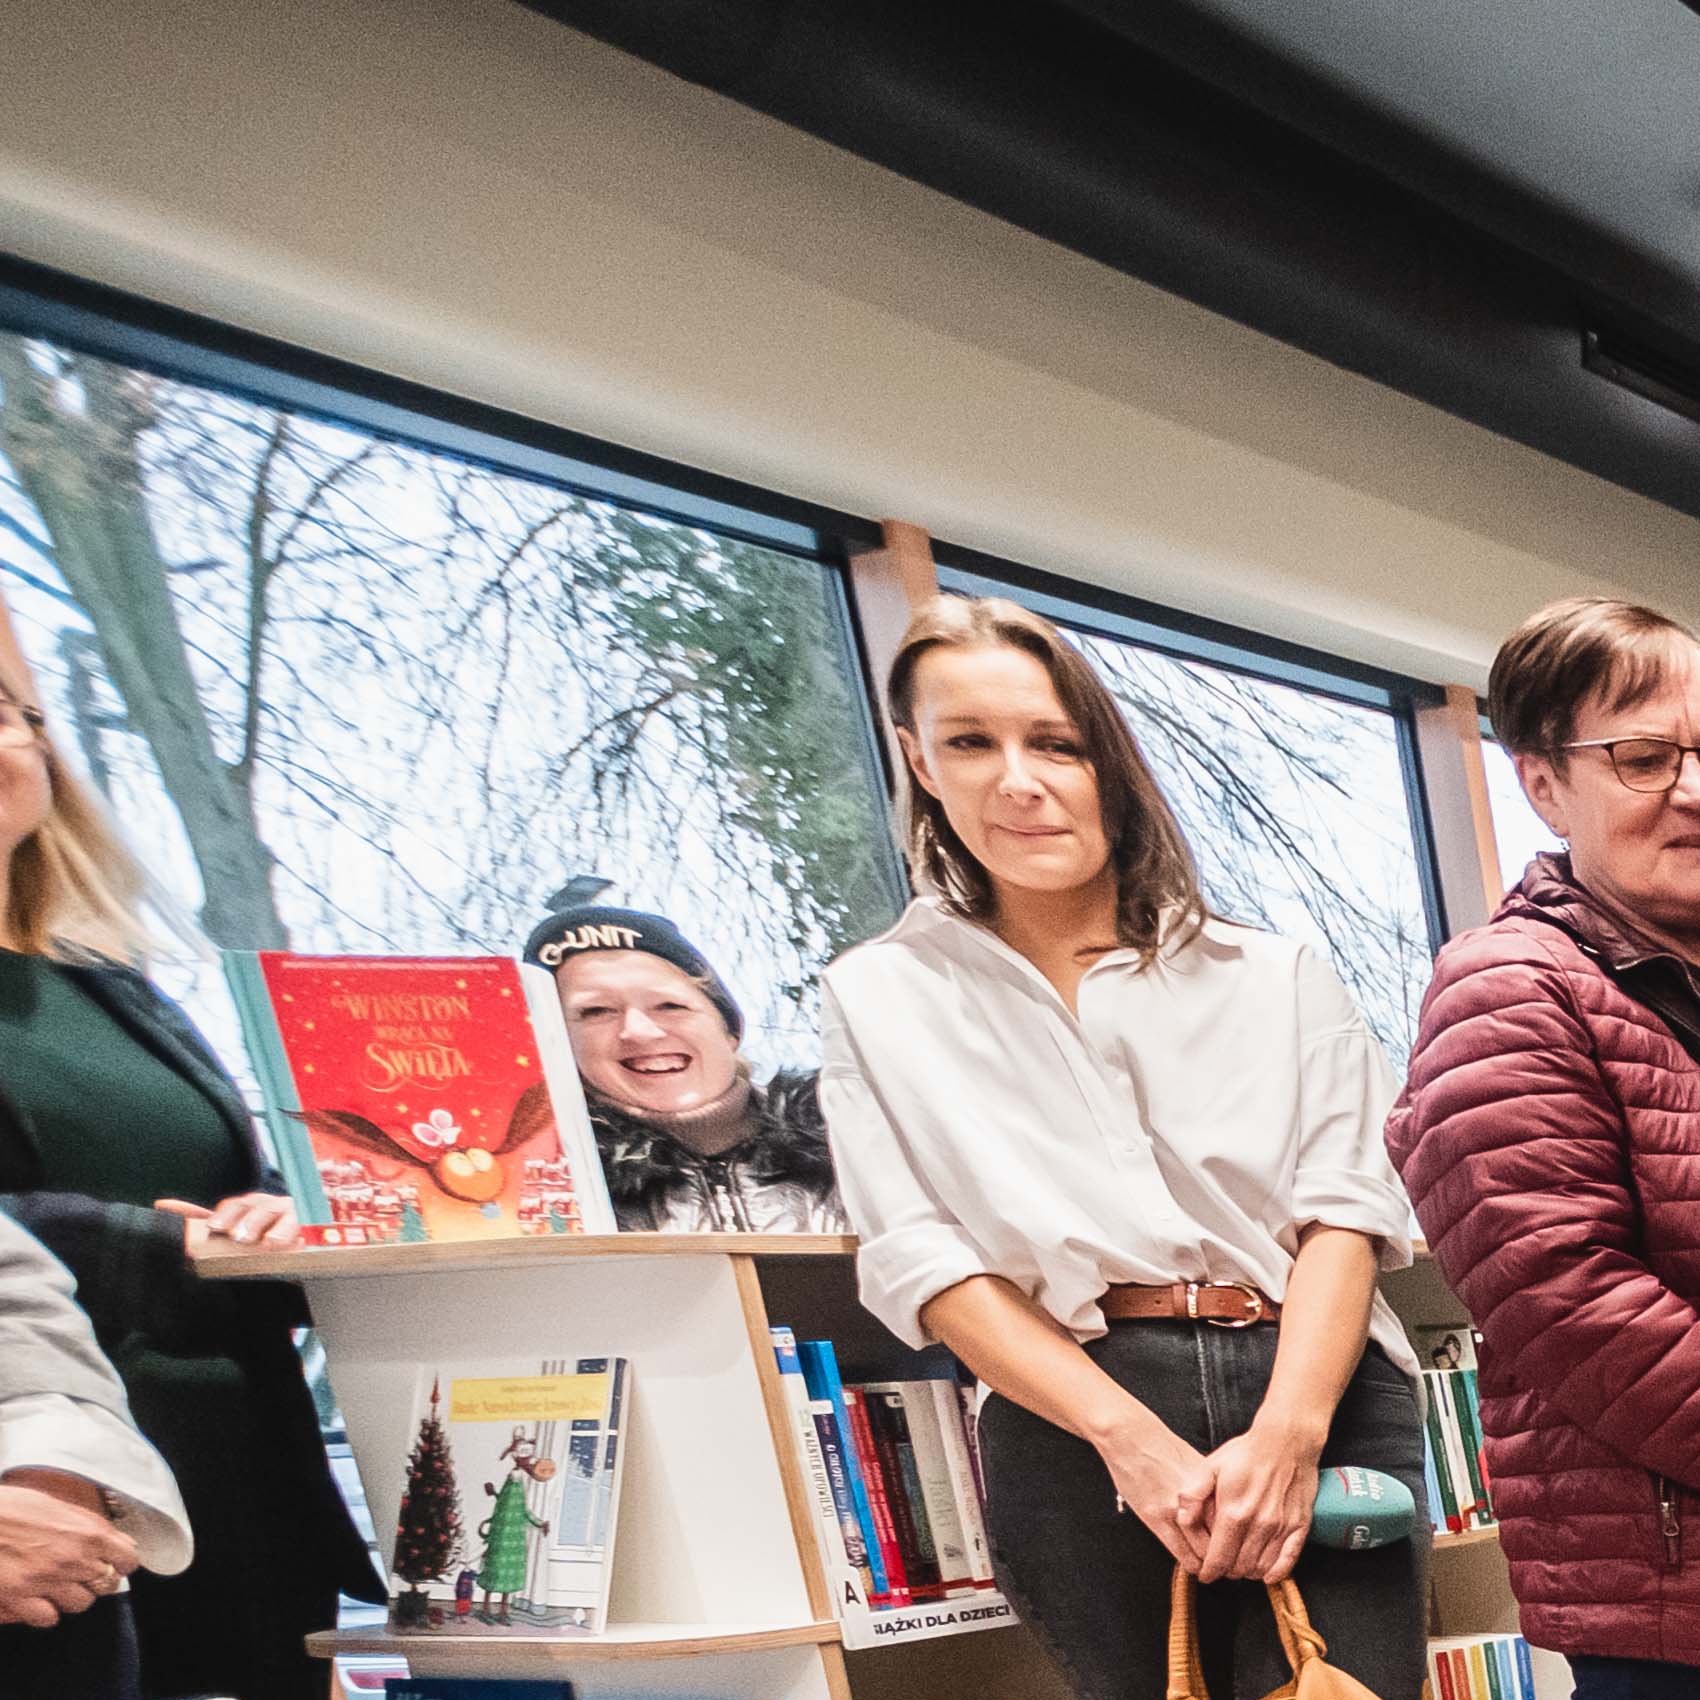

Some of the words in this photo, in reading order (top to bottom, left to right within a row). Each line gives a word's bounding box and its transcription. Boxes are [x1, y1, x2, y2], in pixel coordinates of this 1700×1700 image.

[331, 993, 471, 1021] WINSTON
[845, 1581, 861, 1604] A
[873, 1617, 923, 1636] IĄŻKI
[926, 1612, 958, 1628] DLA
[960, 1604, 1011, 1622] DZIECI
